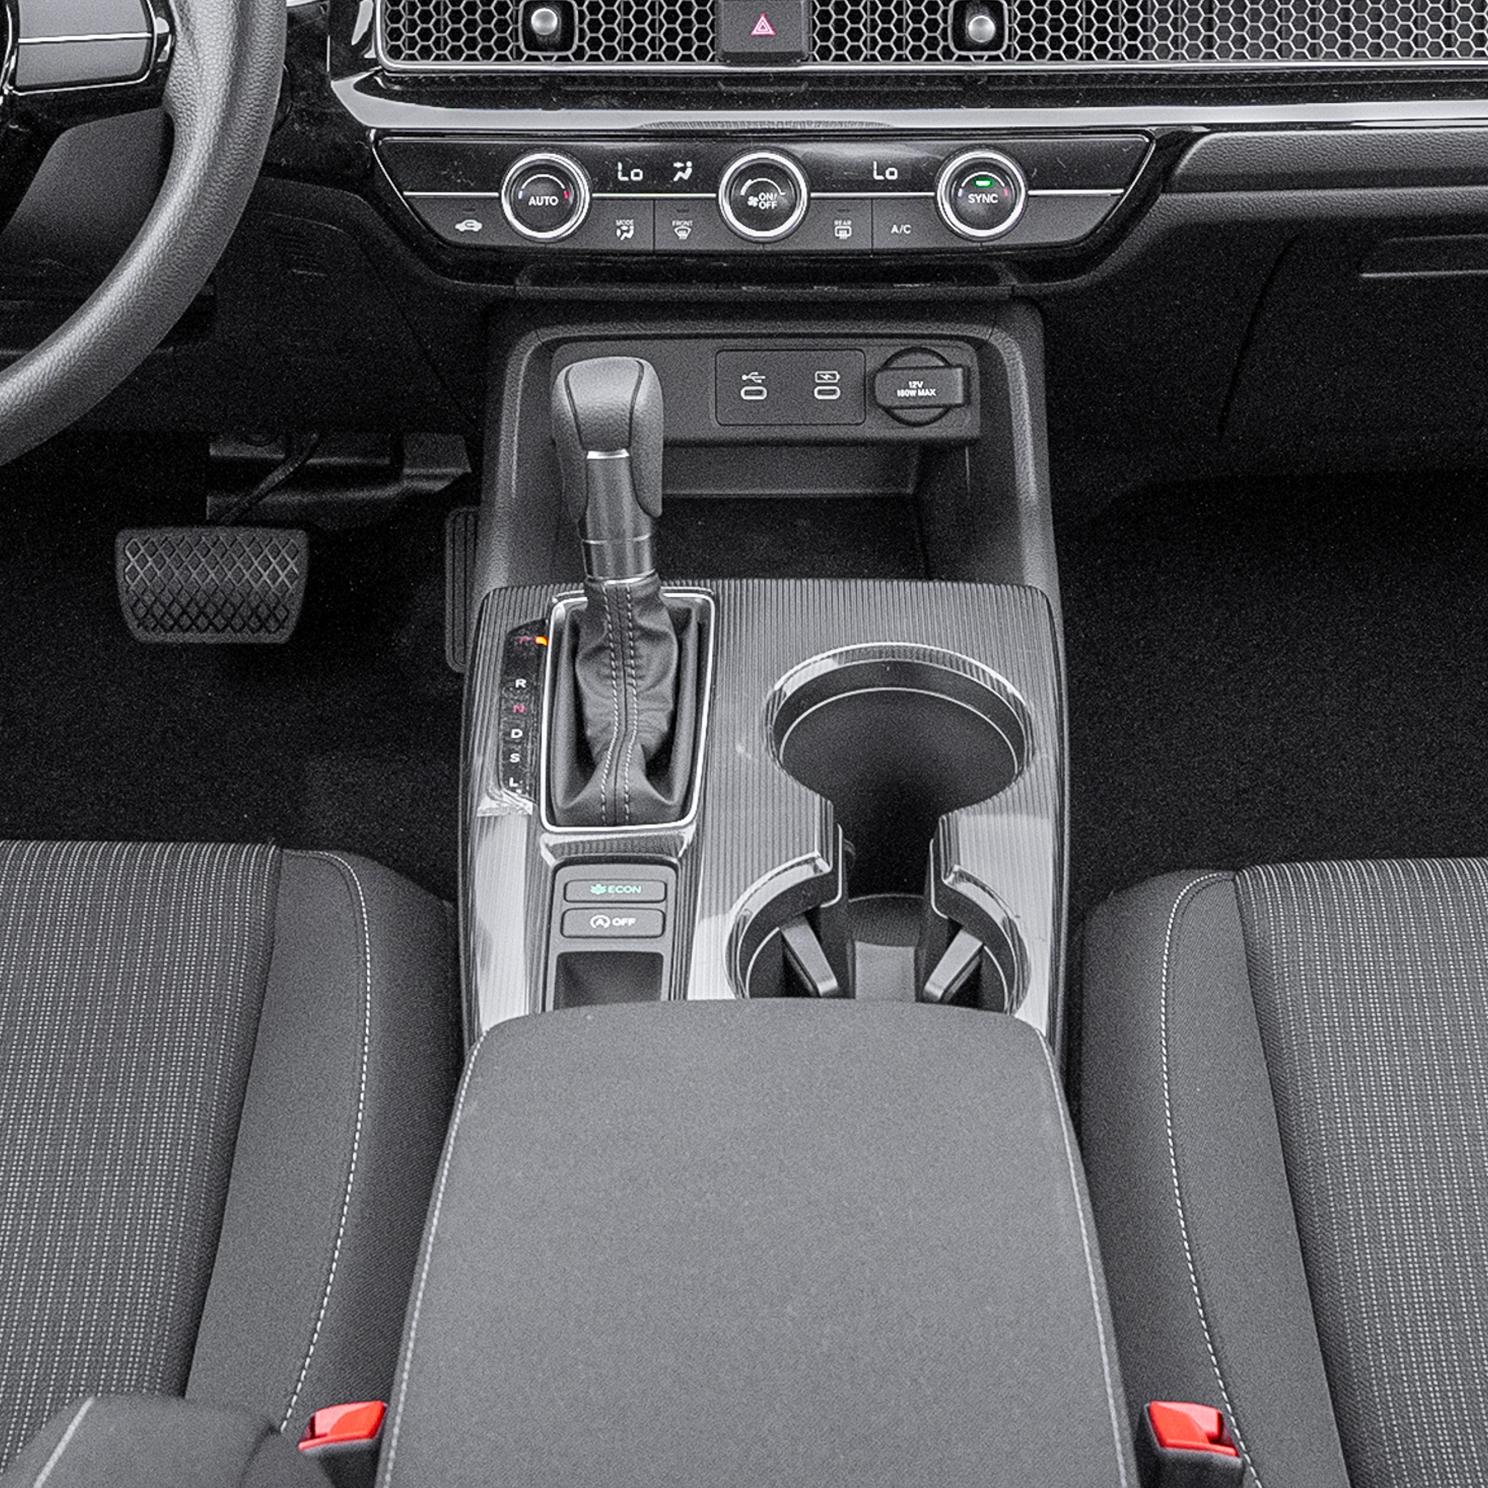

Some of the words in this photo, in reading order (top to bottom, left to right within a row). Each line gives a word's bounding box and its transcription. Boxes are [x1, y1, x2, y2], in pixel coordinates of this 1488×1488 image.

[528, 196, 559, 206] AUTO
[968, 194, 998, 204] SYNC
[759, 201, 777, 210] OFF
[891, 225, 911, 234] A/C
[918, 389, 936, 397] MAX
[515, 679, 527, 688] R
[513, 703, 526, 713] N
[511, 729, 523, 738] D
[510, 753, 520, 762] S
[509, 777, 518, 787] L
[608, 885, 641, 893] ECON
[612, 917, 636, 926] OFF
